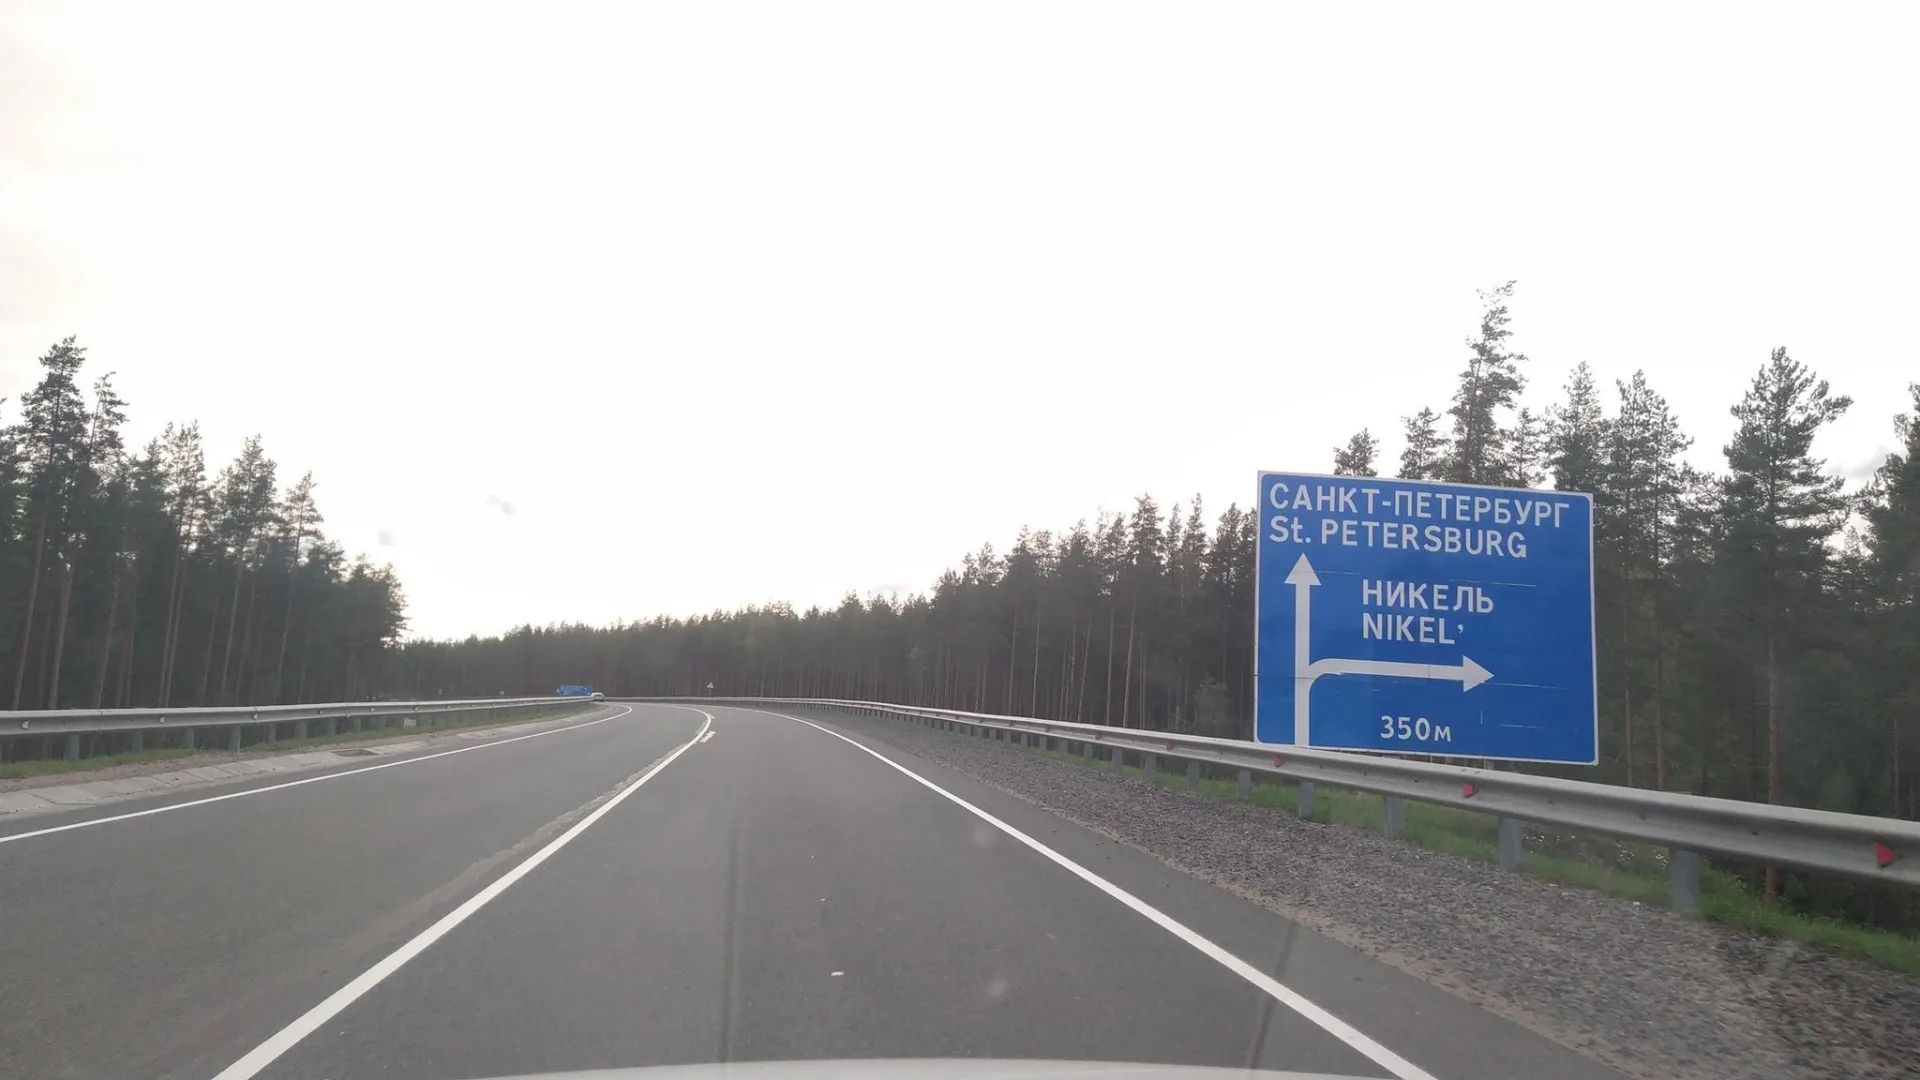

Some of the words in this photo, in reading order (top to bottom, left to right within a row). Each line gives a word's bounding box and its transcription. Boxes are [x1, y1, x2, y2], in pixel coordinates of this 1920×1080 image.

[1269, 482, 1571, 528] САНКТ-ПЕТЕРБУРГ
[1269, 515, 1312, 544] St.
[1320, 518, 1527, 558] PETERSBURG
[1362, 579, 1494, 614] НИКЕЛЬ
